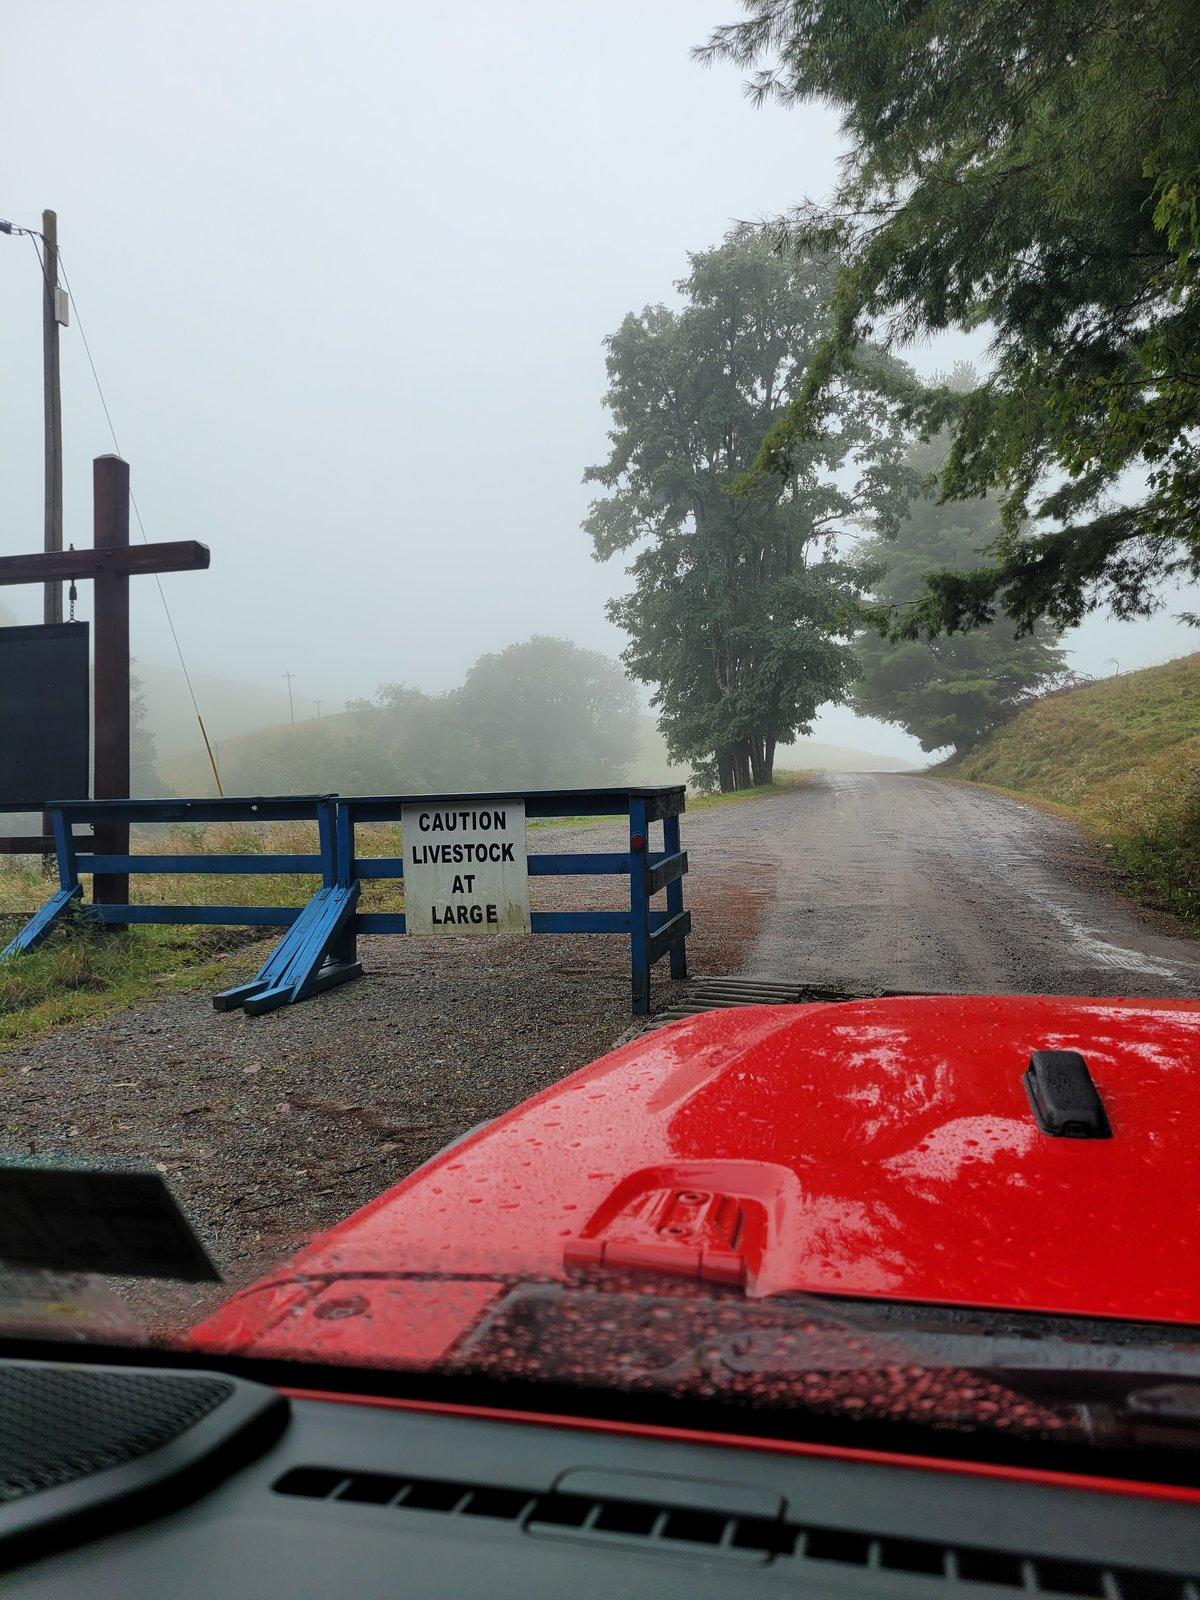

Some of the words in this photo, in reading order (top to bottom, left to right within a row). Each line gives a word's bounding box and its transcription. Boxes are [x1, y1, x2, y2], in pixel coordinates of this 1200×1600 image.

[419, 811, 506, 832] CAUTION
[412, 843, 515, 864] LIVESTOCK
[452, 875, 475, 894] AT
[431, 905, 498, 924] LARGE
